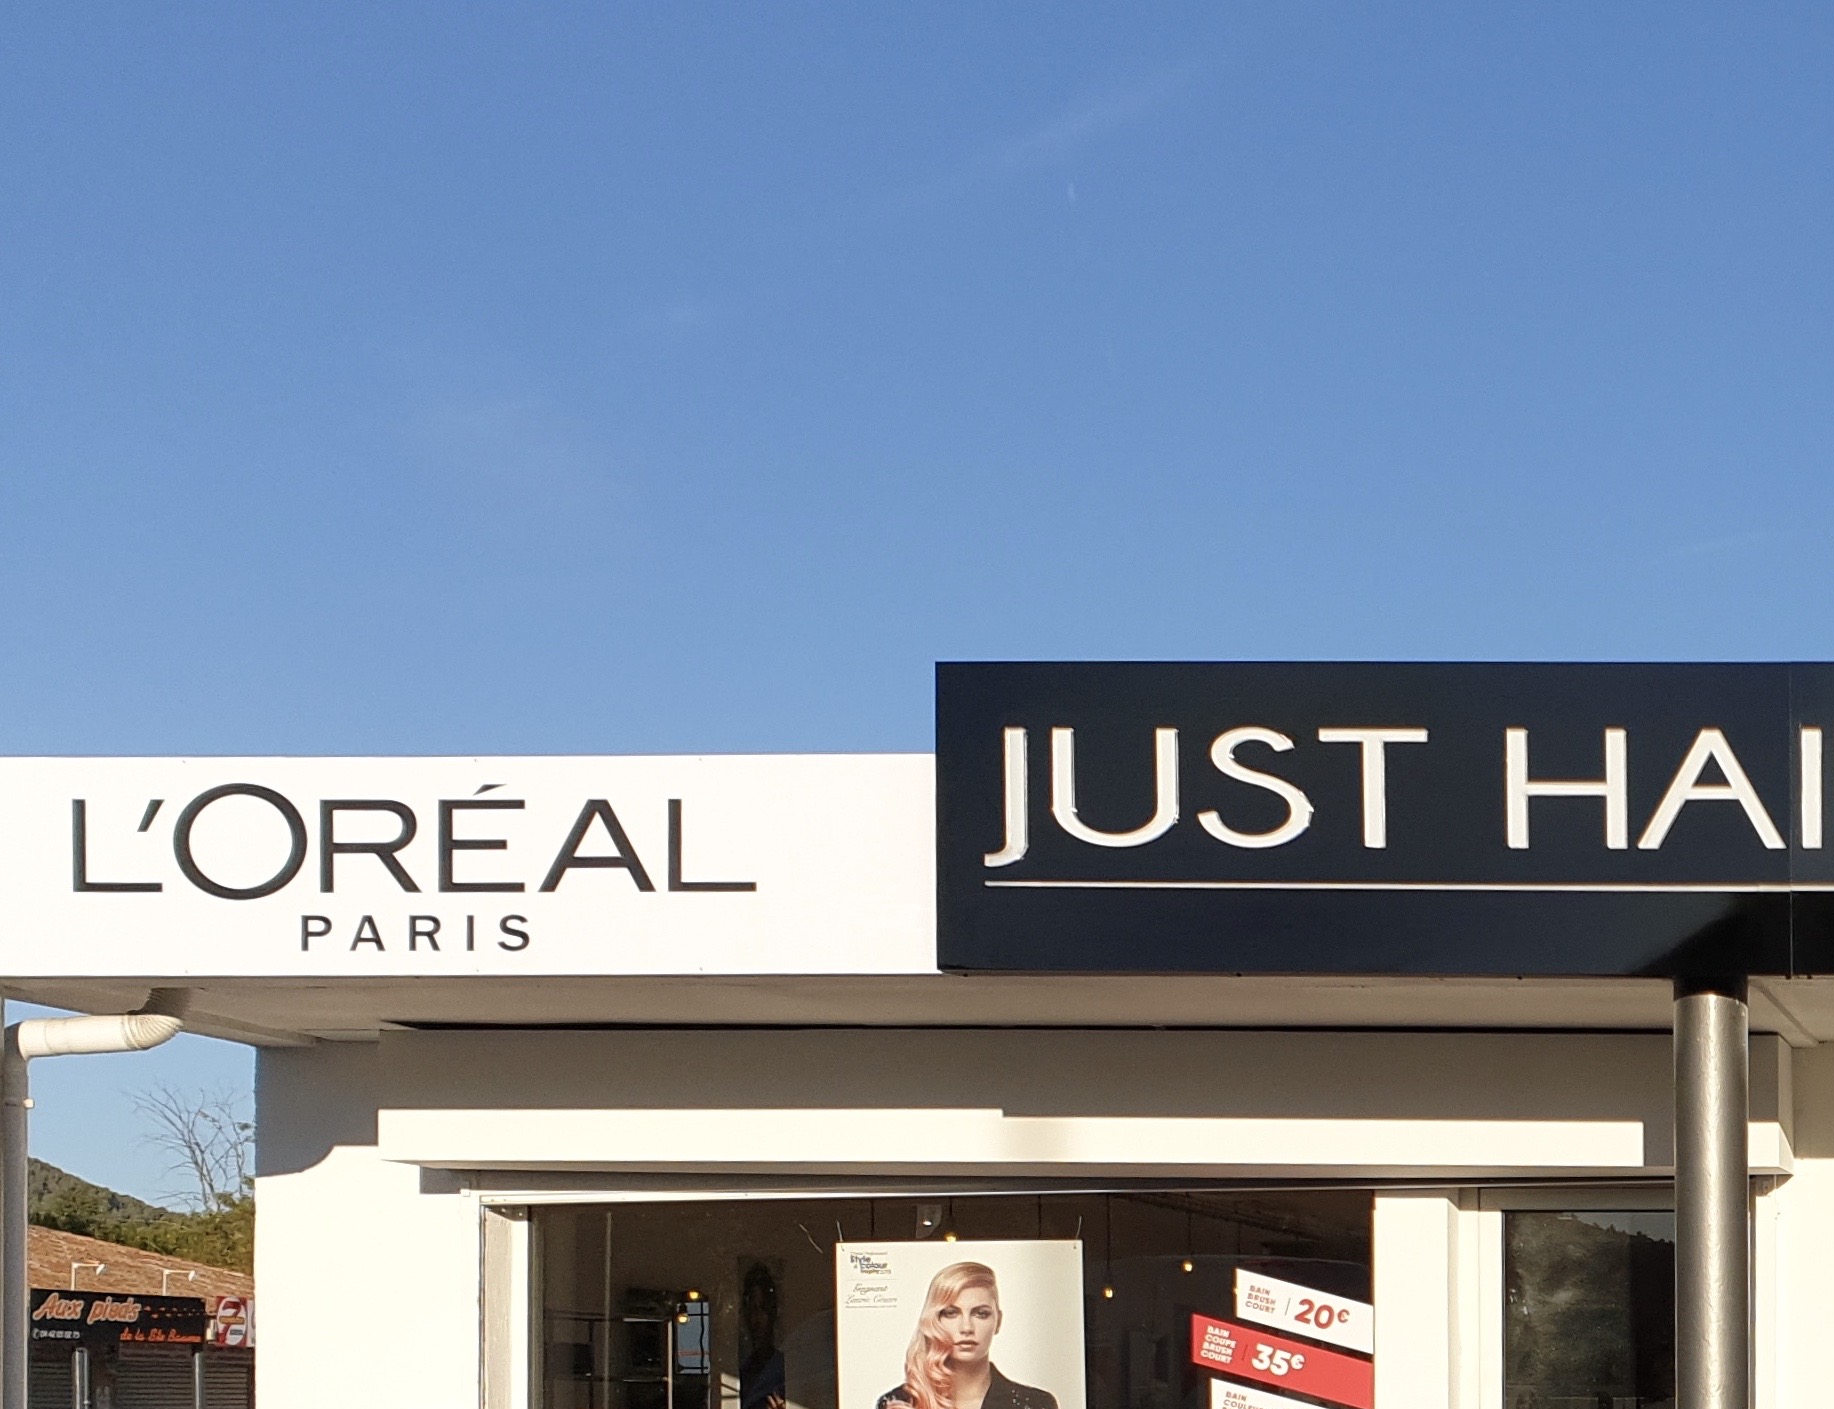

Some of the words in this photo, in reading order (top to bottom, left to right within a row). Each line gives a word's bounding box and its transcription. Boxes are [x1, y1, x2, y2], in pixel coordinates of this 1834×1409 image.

[984, 727, 1429, 868] JUST
[72, 782, 757, 900] L'ORÉAL
[301, 914, 531, 952] PARIS
[1249, 1285, 1271, 1296] BAIN
[33, 1292, 84, 1321] Aux
[87, 1296, 142, 1324] pieds
[1245, 1301, 1276, 1315] COURT
[1294, 1298, 1350, 1330] 20€
[1207, 1325, 1230, 1338] BAIN
[1251, 1343, 1306, 1376] 35€
[1225, 1391, 1247, 1402] BAIN
